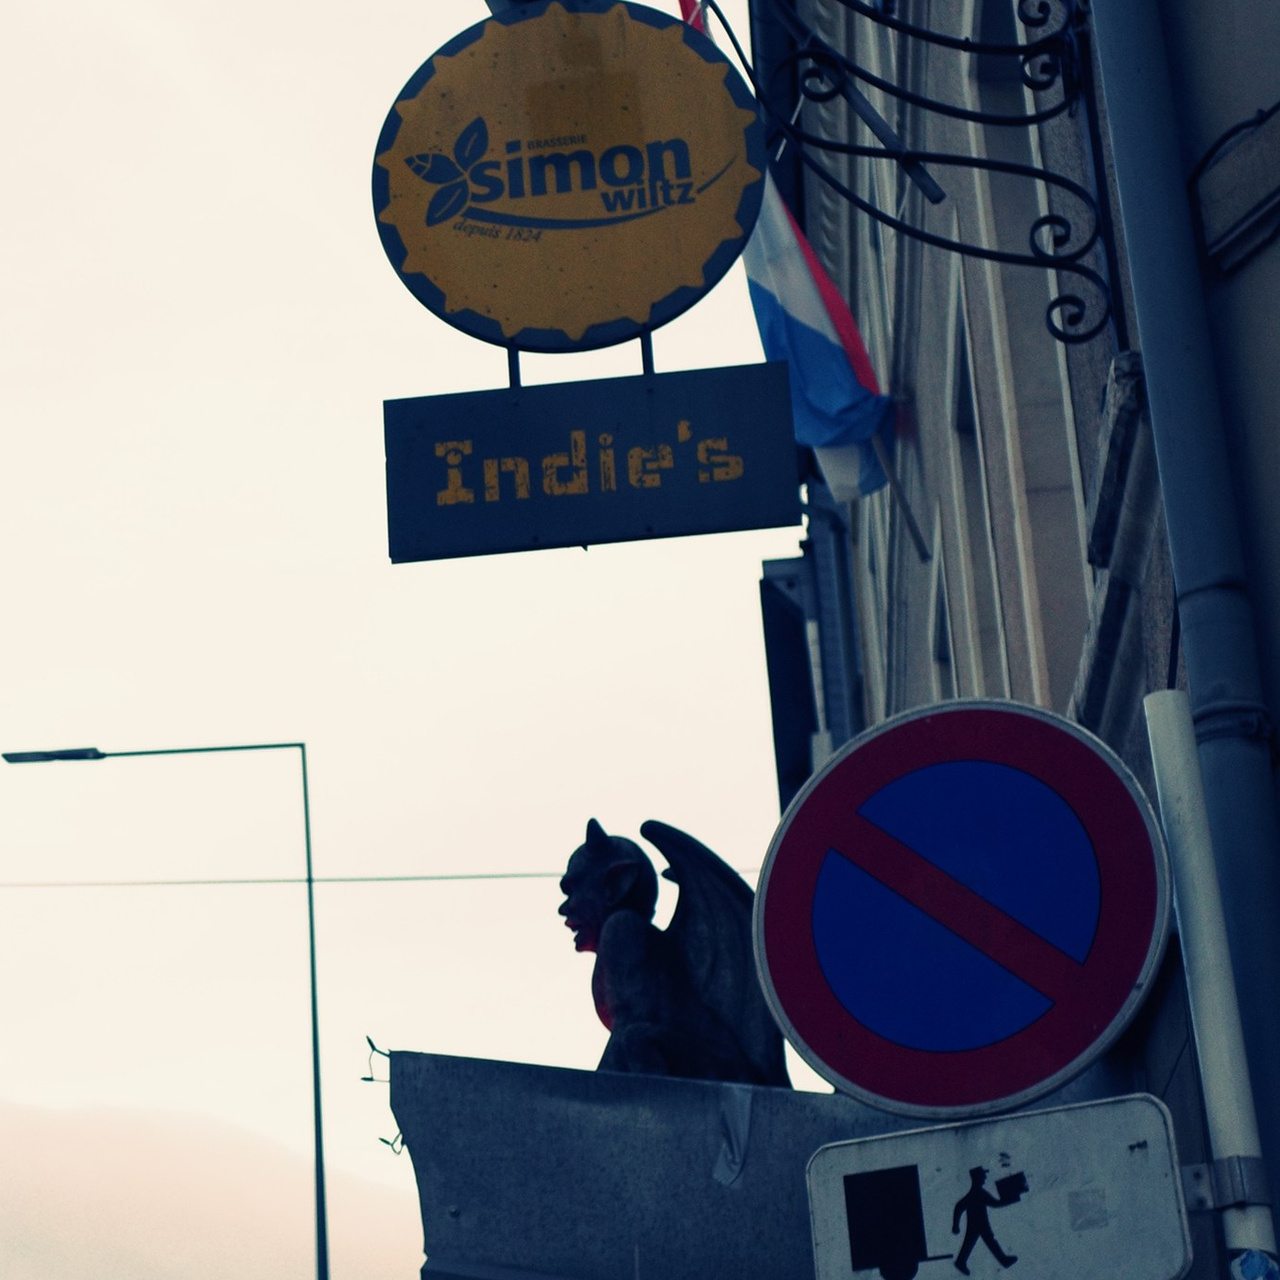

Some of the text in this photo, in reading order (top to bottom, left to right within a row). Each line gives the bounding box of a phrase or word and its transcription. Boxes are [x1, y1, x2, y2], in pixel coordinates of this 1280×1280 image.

[527, 133, 588, 150] BRASSERIE
[470, 136, 692, 203] simon
[600, 177, 696, 213] wiltz
[453, 219, 543, 243] depuis 1824
[434, 419, 745, 506] Indie's
